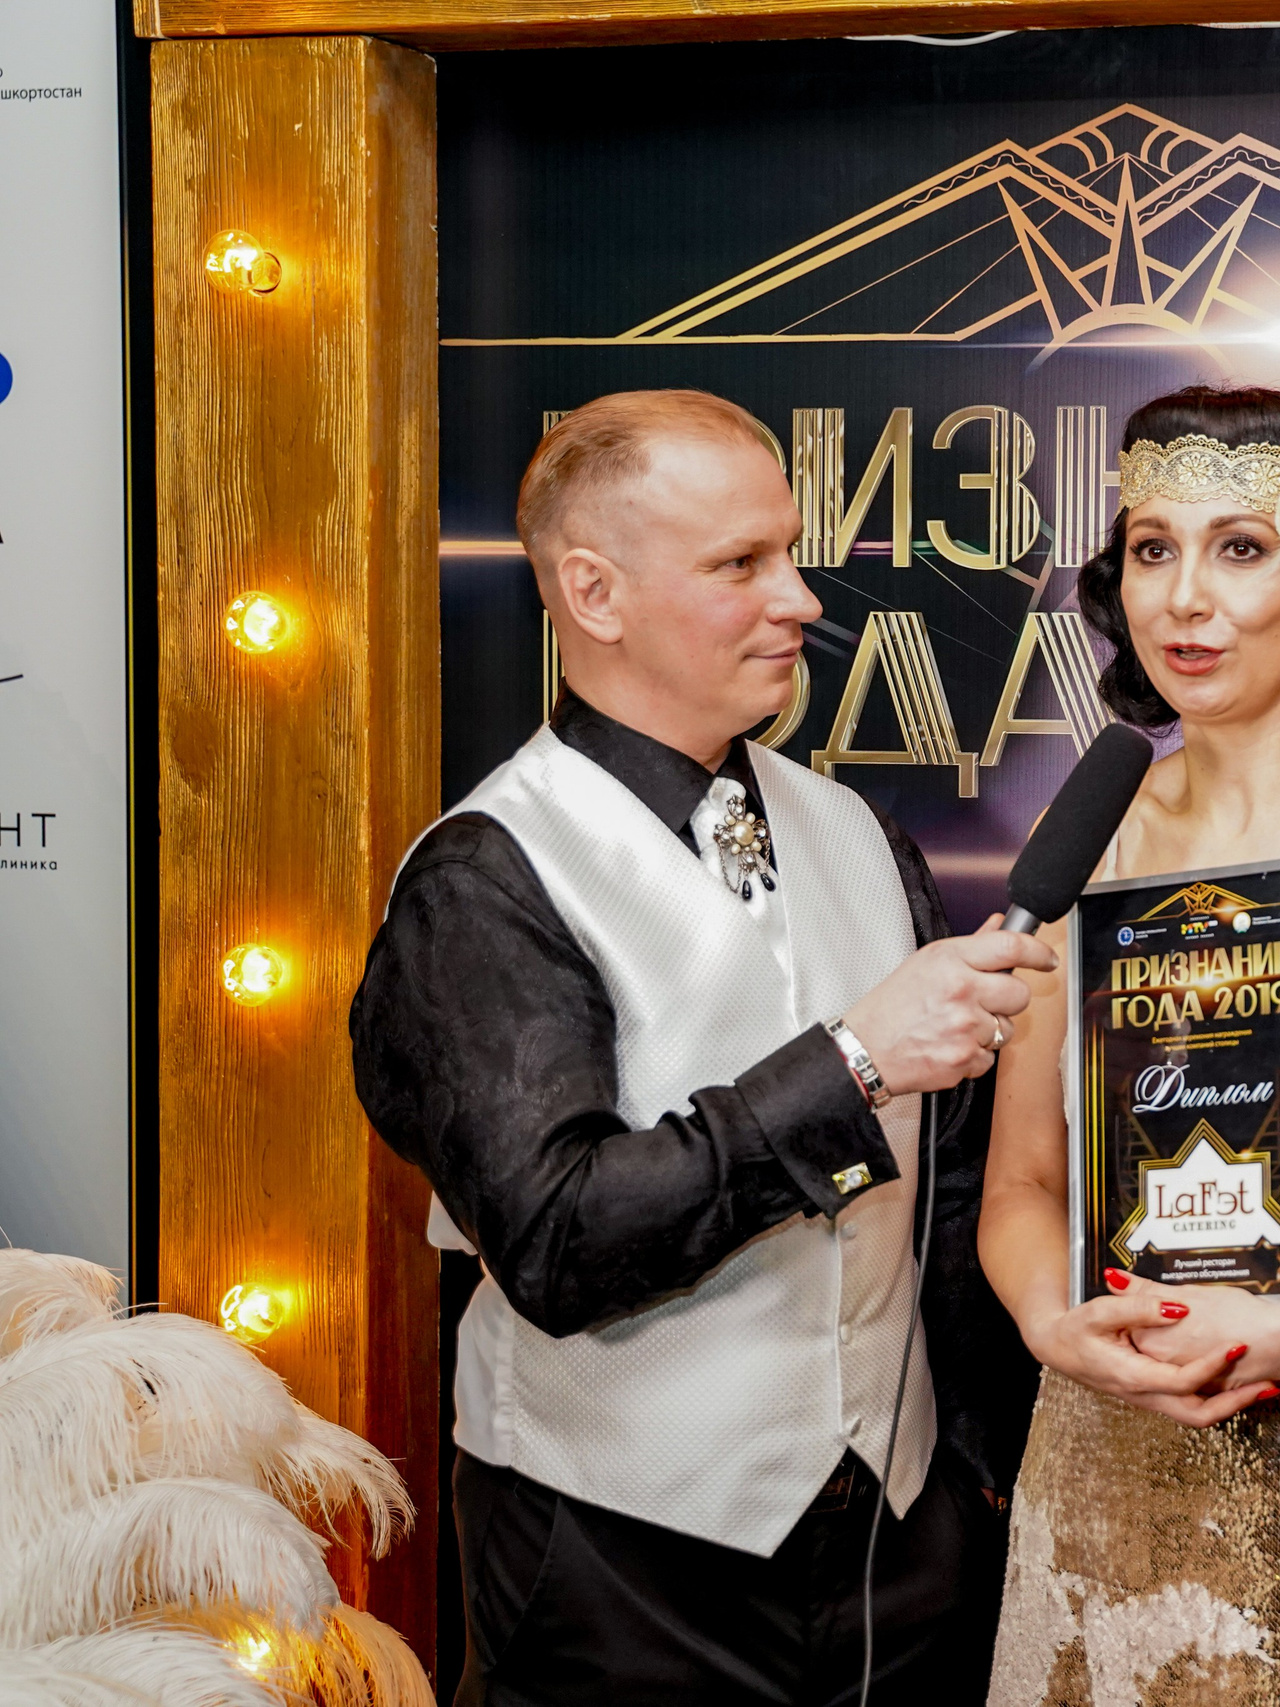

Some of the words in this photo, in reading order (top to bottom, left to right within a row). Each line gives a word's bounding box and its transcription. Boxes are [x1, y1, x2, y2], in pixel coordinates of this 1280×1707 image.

[1111, 990, 1205, 1032] ГОДА
[1132, 1063, 1274, 1114] Диплом
[1173, 1219, 1237, 1232] CATERING
[1202, 1257, 1236, 1268] ресторан
